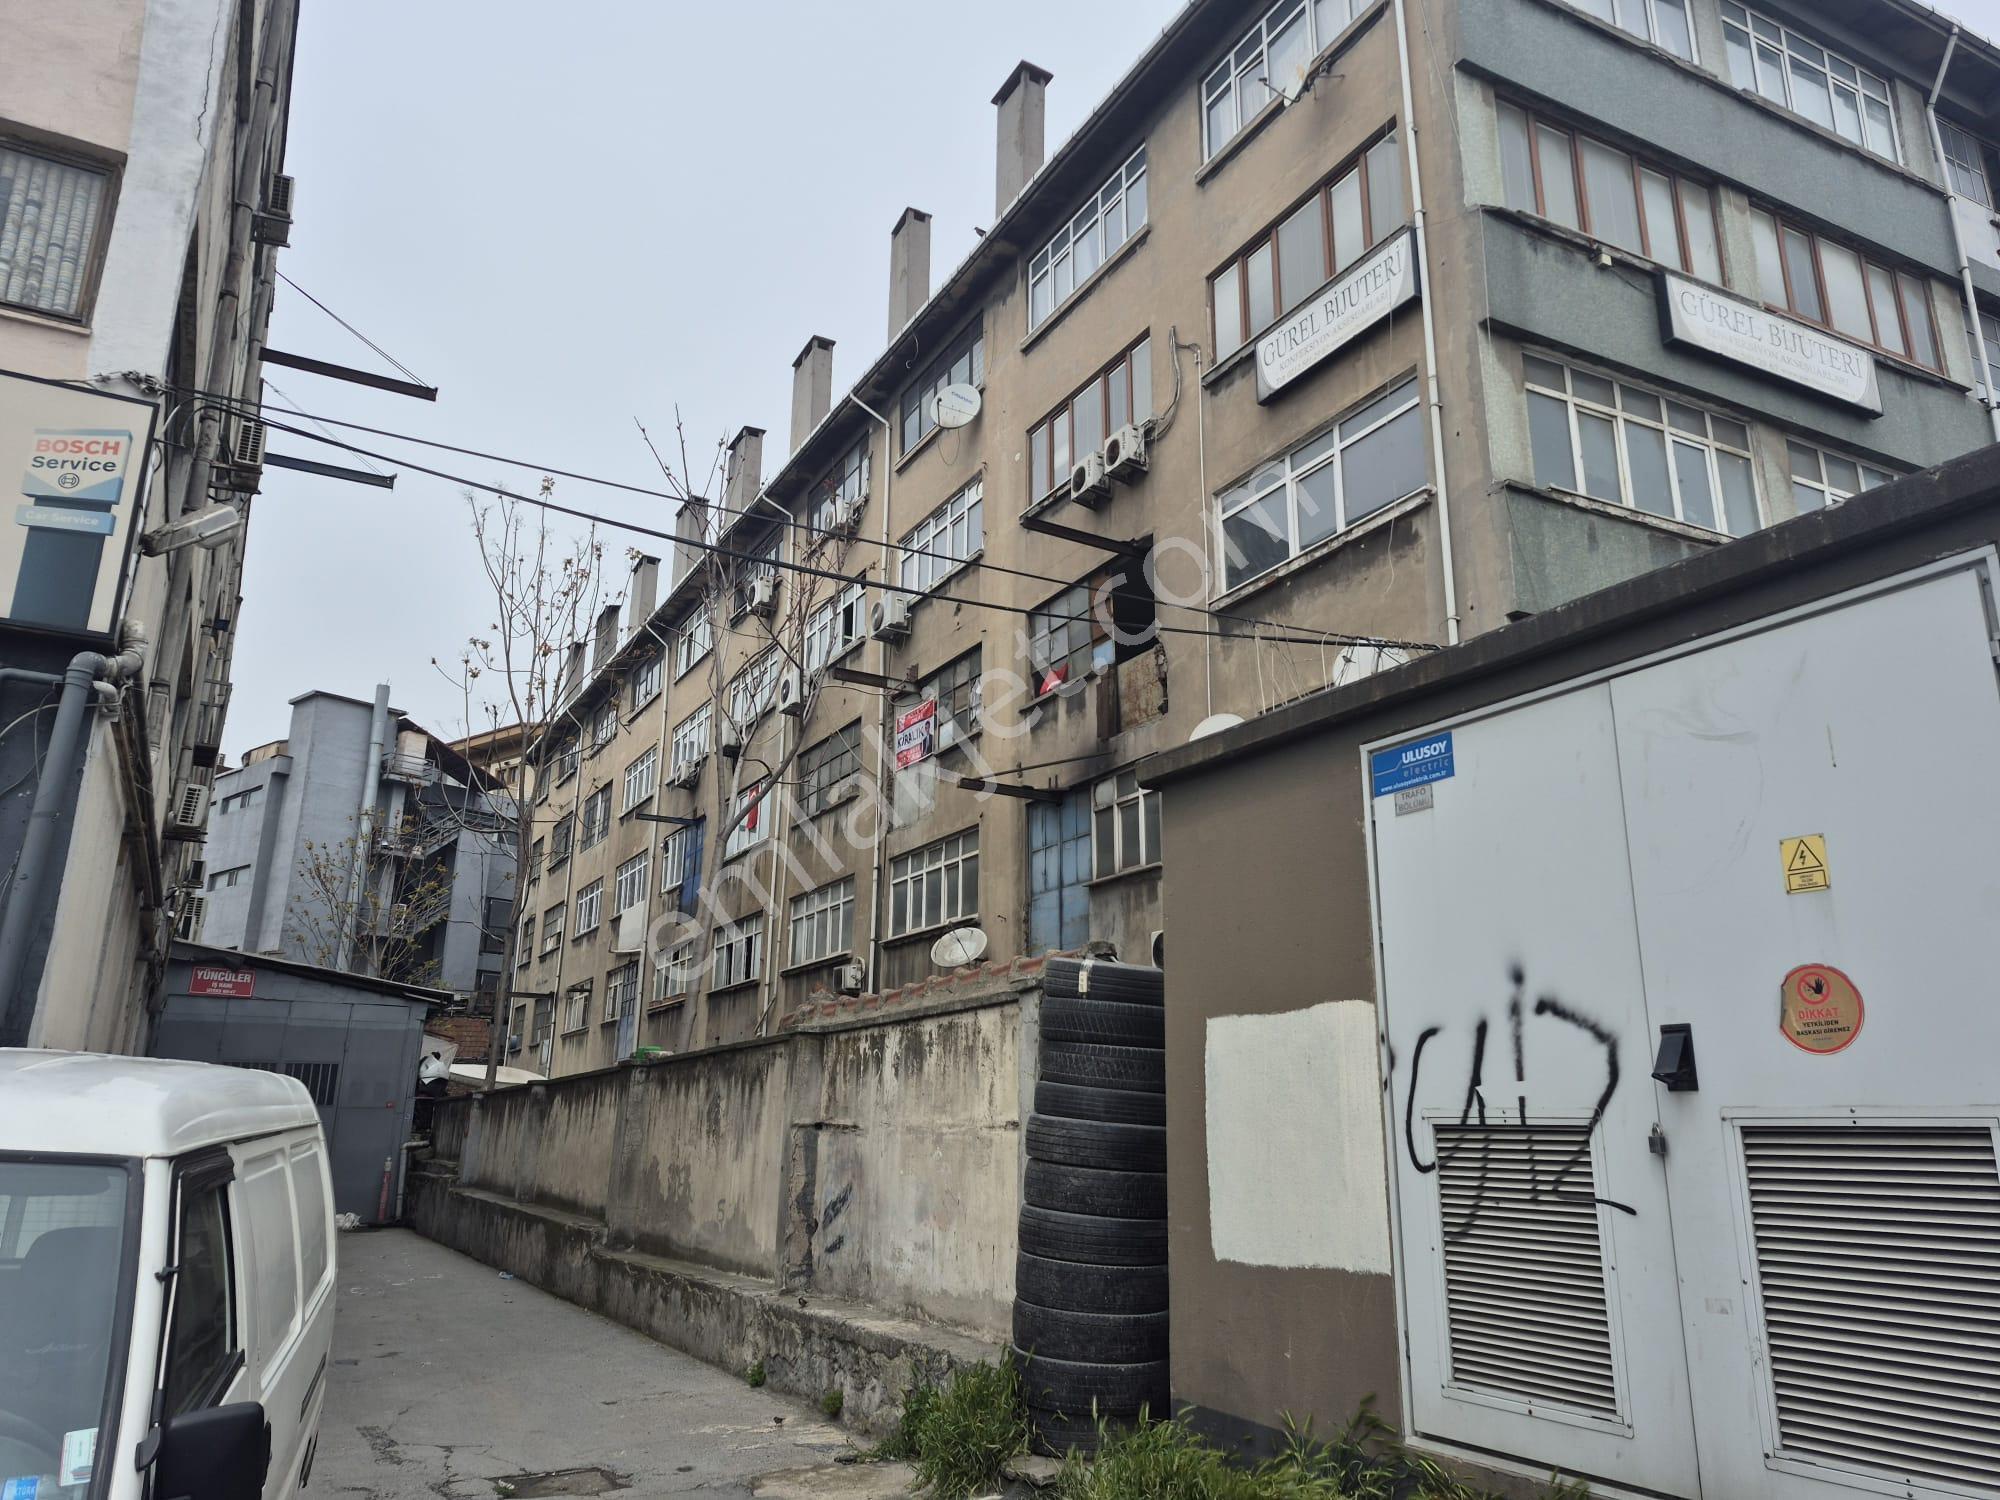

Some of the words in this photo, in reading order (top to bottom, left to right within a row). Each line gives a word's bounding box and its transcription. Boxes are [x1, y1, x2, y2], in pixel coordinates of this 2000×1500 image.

[1263, 311, 1320, 368] GÜREL
[1324, 245, 1402, 326] BİJUTERİ
[1680, 290, 1761, 342] GÜREL
[1768, 323, 1863, 379] BİJUTERİ
[35, 439, 121, 456] BOSCH
[31, 456, 117, 472] Service
[52, 512, 99, 526] Service
[1401, 740, 1447, 764] ULUSOY
[1403, 758, 1449, 778] electric
[1401, 787, 1426, 801] TRAFO
[1798, 1007, 1840, 1020] DİKKAT
